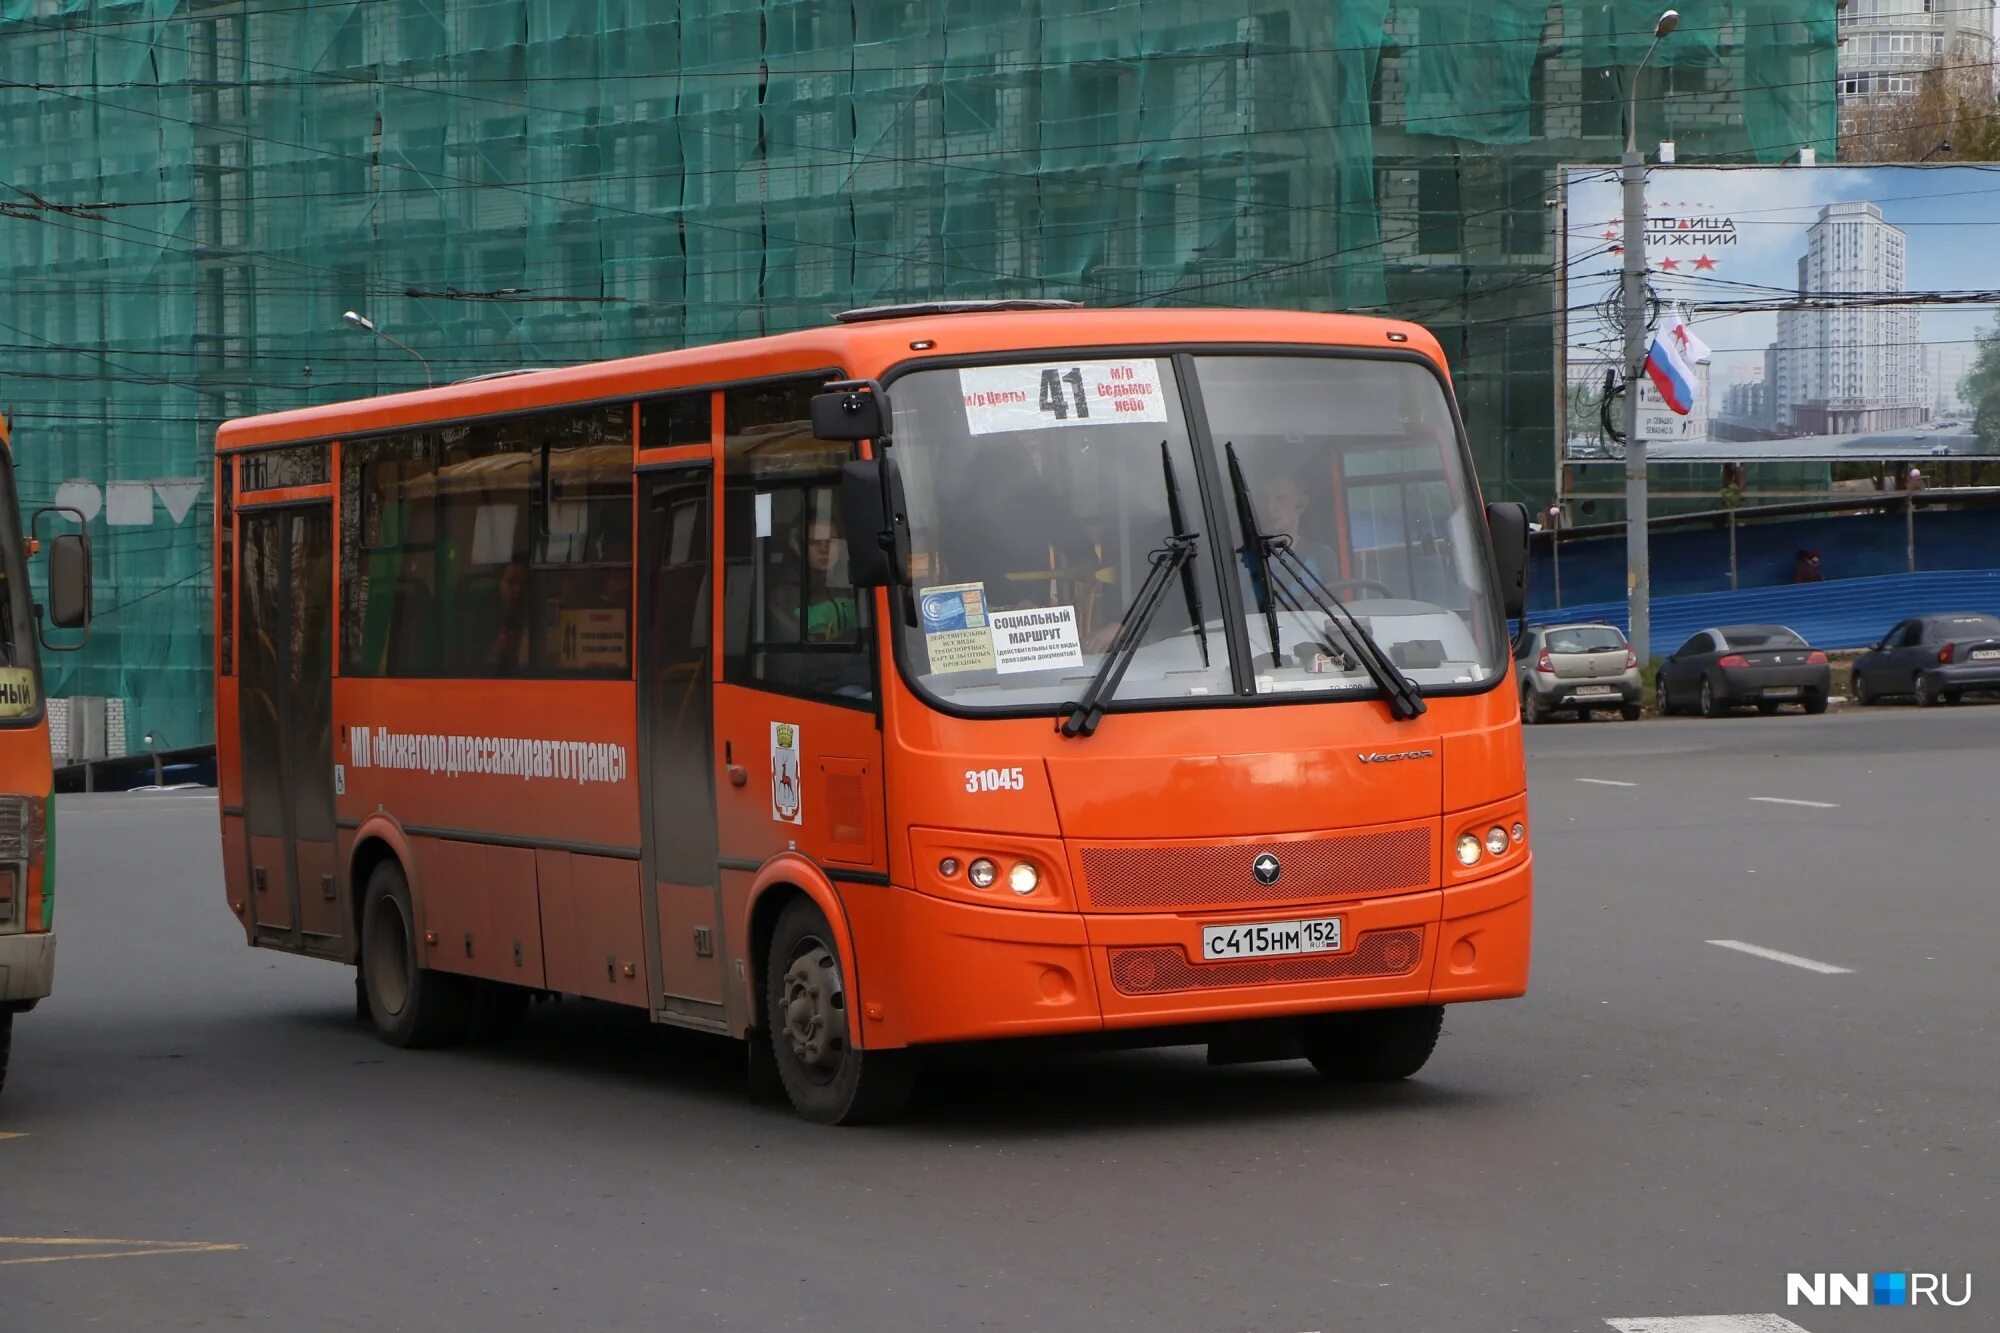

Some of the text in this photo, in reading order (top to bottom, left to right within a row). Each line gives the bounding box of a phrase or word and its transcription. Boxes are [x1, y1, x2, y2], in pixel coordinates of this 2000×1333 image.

[1652, 217, 1736, 231] ТОЛИЦА
[1110, 365, 1134, 380] м/р
[986, 389, 1026, 406] Цветы
[1039, 367, 1090, 420] 41
[1097, 381, 1153, 397] Седьмое
[1114, 398, 1145, 413] небо
[994, 609, 1071, 630] СОЦИАЛЬНЫЙ
[1008, 628, 1061, 645] МАРШРУТ
[0, 676, 31, 705] НЫЙ
[350, 726, 371, 768] МП
[965, 767, 1024, 793] 31045
[1303, 922, 1335, 942] 152
[1309, 941, 1326, 949] RUS
